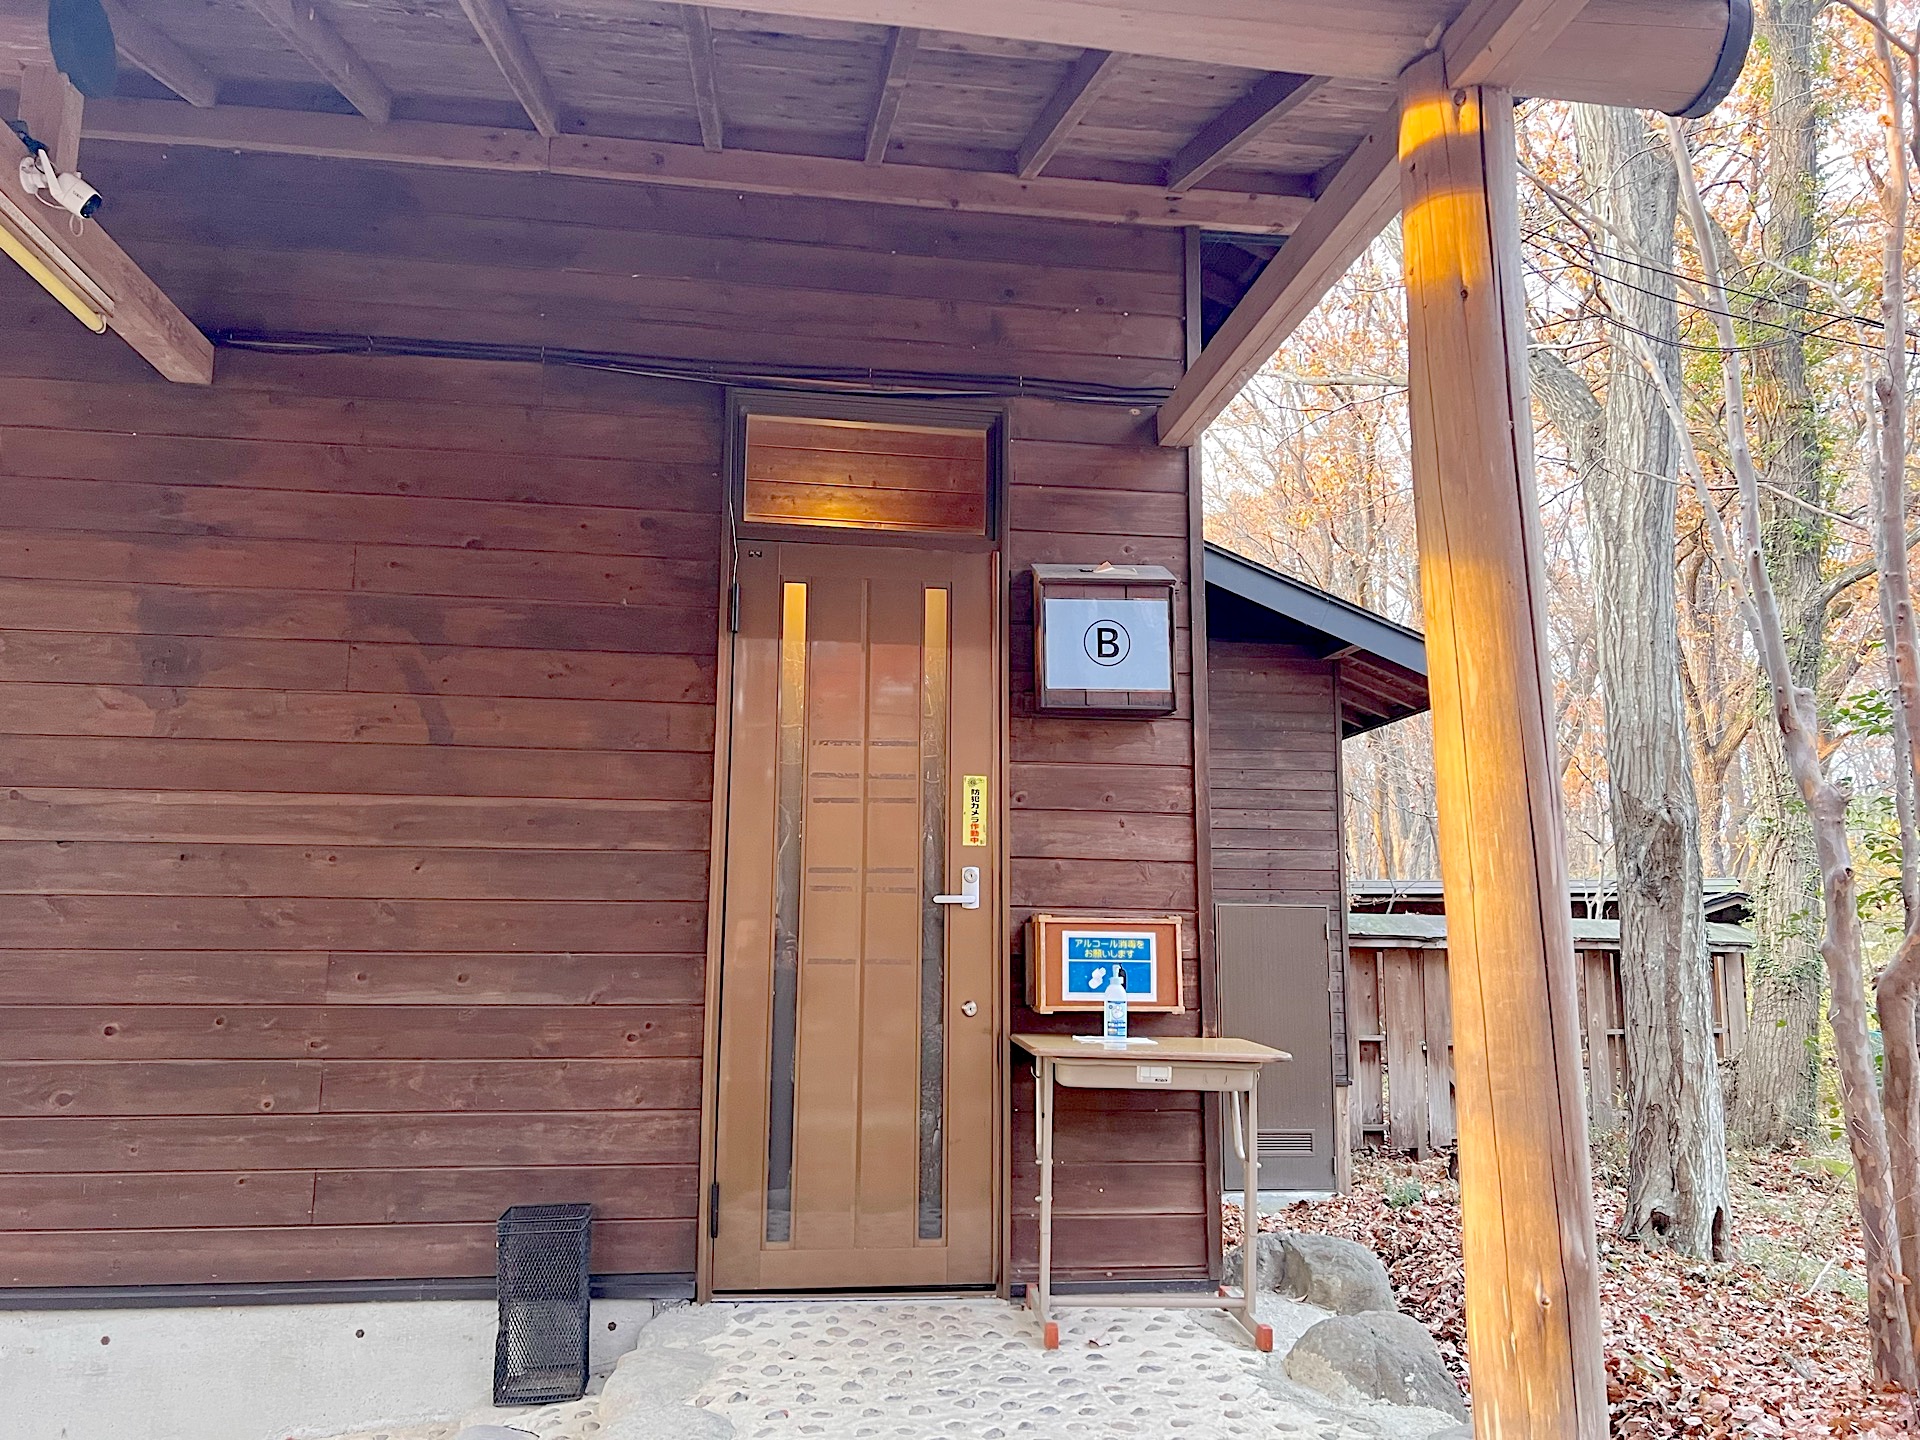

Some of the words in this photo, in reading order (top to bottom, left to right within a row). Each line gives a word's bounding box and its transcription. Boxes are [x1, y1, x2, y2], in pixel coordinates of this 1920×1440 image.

[1097, 627, 1119, 658] B
[970, 789, 980, 843] 防犯カメラ作動中
[1075, 939, 1145, 949] アルコール消毒を
[1084, 949, 1135, 959] お願いします
